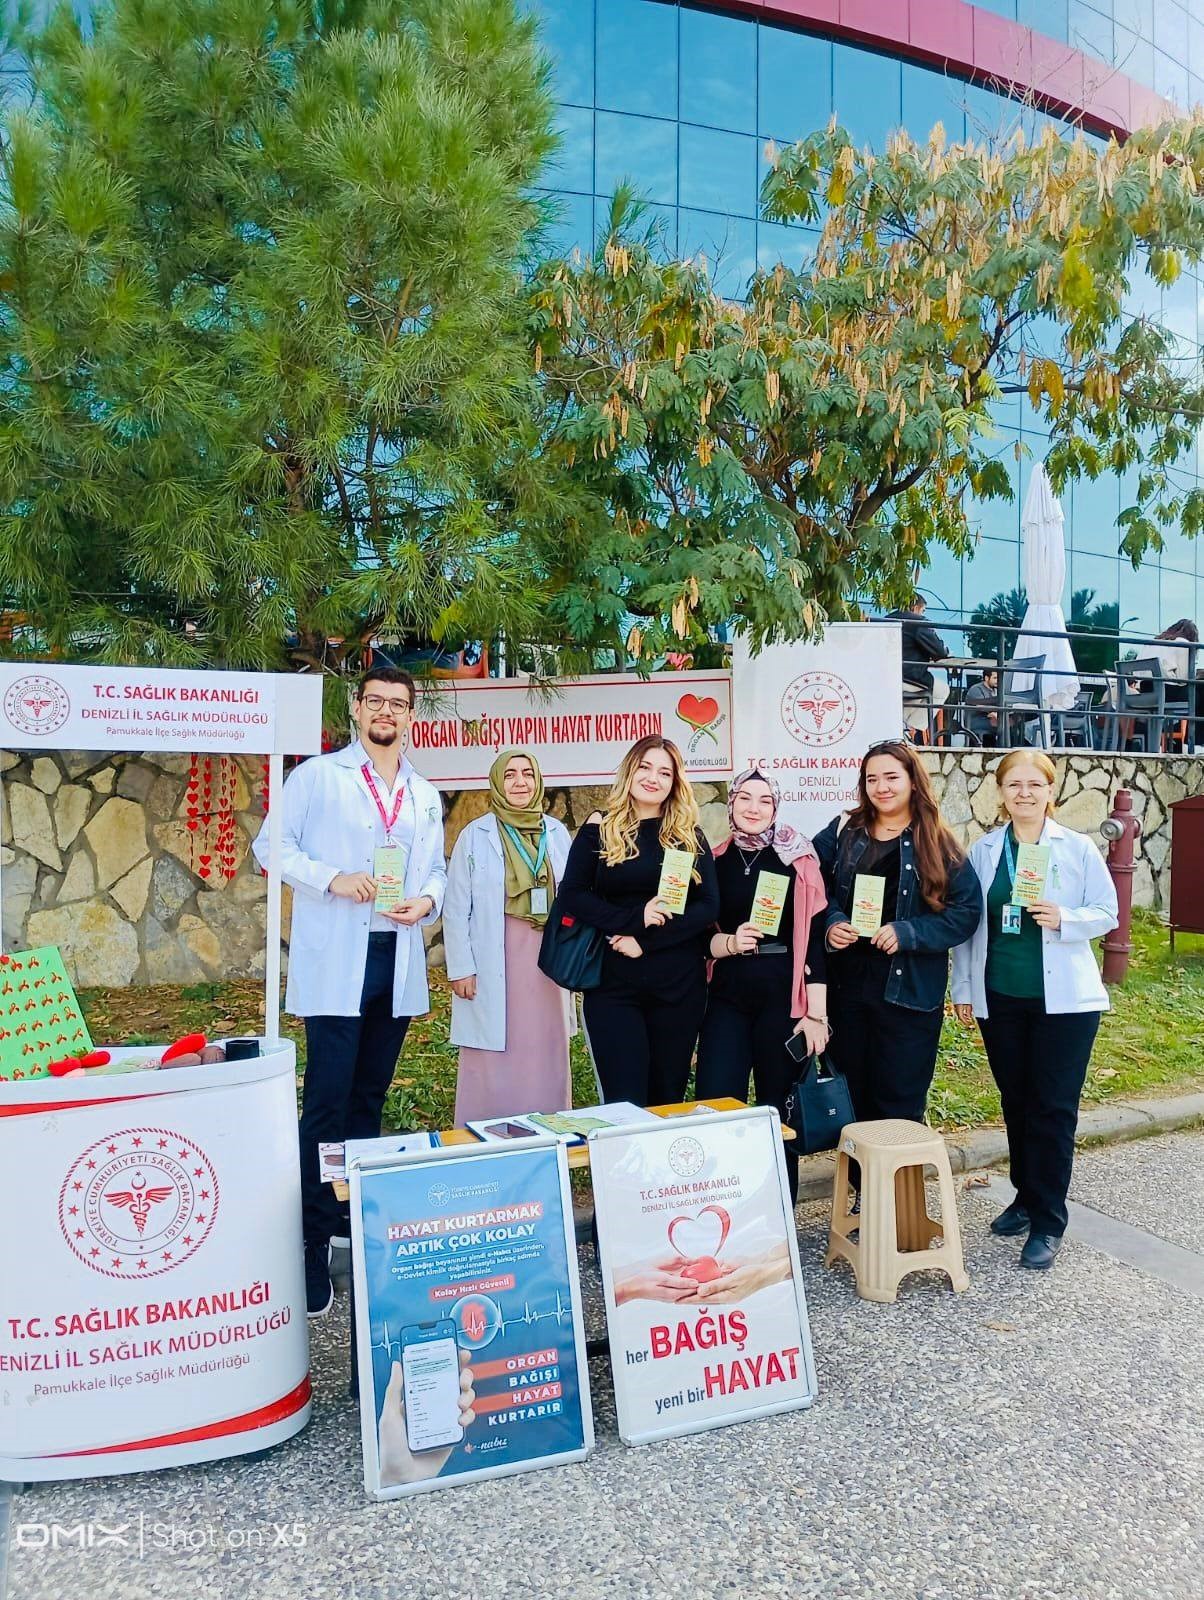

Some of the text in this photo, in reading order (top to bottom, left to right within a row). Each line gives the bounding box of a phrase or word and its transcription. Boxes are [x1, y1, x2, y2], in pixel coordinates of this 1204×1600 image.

[93, 684, 259, 704] T.C. SAĞLIK BAKANLIĞI
[81, 708, 269, 725] DENİZLİ İL SAĞLIK MÜDÜRLÜĞÜ
[106, 726, 153, 737] Pamukkale
[172, 728, 197, 739] Sağlık
[198, 728, 245, 741] Müdürlüğü
[411, 712, 662, 753] ORGAN BAĞIŞI YAPIN HAYAT KURTARIN
[772, 755, 819, 769] SAĞLIK
[821, 758, 863, 769] BAKAN
[798, 774, 841, 787] DENİZLİ
[89, 1154, 190, 1247] TÜRKİYE CUMHURİYETİ SAĞLIK BAKANLIĞI
[640, 1176, 740, 1201] T.C. SAĞLIK BAKANLIĞI
[387, 1204, 541, 1240] HAYAT KURTARMAK
[396, 1223, 536, 1257] ARTIK ÇOK KOLAY
[392, 1265, 413, 1274] Organ
[434, 1278, 510, 1299] Kolay Hızlı Güvenli
[8, 1280, 270, 1339] T.C. SAĞLIK BAKANLIĞI
[0, 1305, 291, 1371] ENİZLİ İL SAĞLIK MÜDÜRLÜĞÜ
[625, 1306, 748, 1365] her BAĞIŞ
[506, 1351, 556, 1370] ORGAN
[34, 1353, 251, 1396] Pamukkale İlçe Sağlık Müdürlüğü
[509, 1368, 557, 1387] BAĞIŞI
[655, 1347, 800, 1415] yeni bir HAYAT
[512, 1384, 559, 1404] HAYAT
[488, 1402, 560, 1426] KURTARIR
